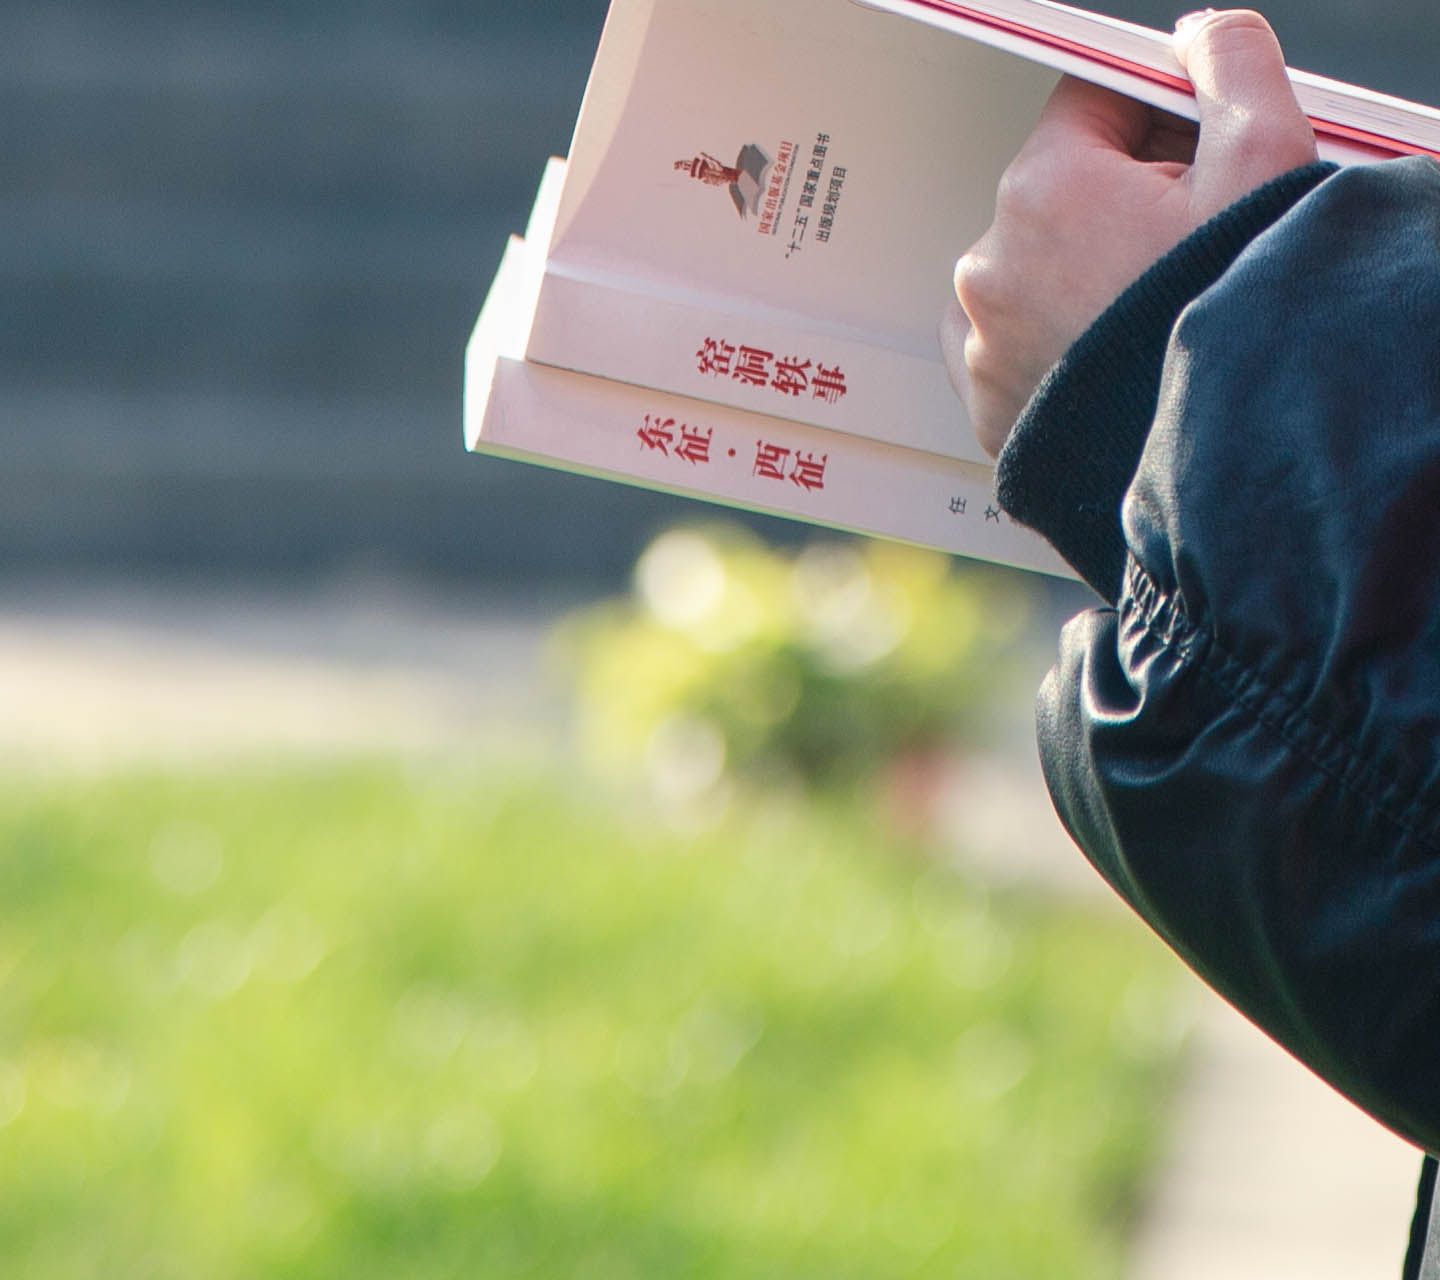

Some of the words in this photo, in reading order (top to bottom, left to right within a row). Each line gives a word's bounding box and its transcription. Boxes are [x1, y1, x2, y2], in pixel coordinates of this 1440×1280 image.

[758, 140, 793, 235] 国家出版基金项目
[816, 166, 847, 243] 出版规划项目
[696, 336, 848, 405] 窑洞轶事
[636, 413, 828, 493] 东征·西征
